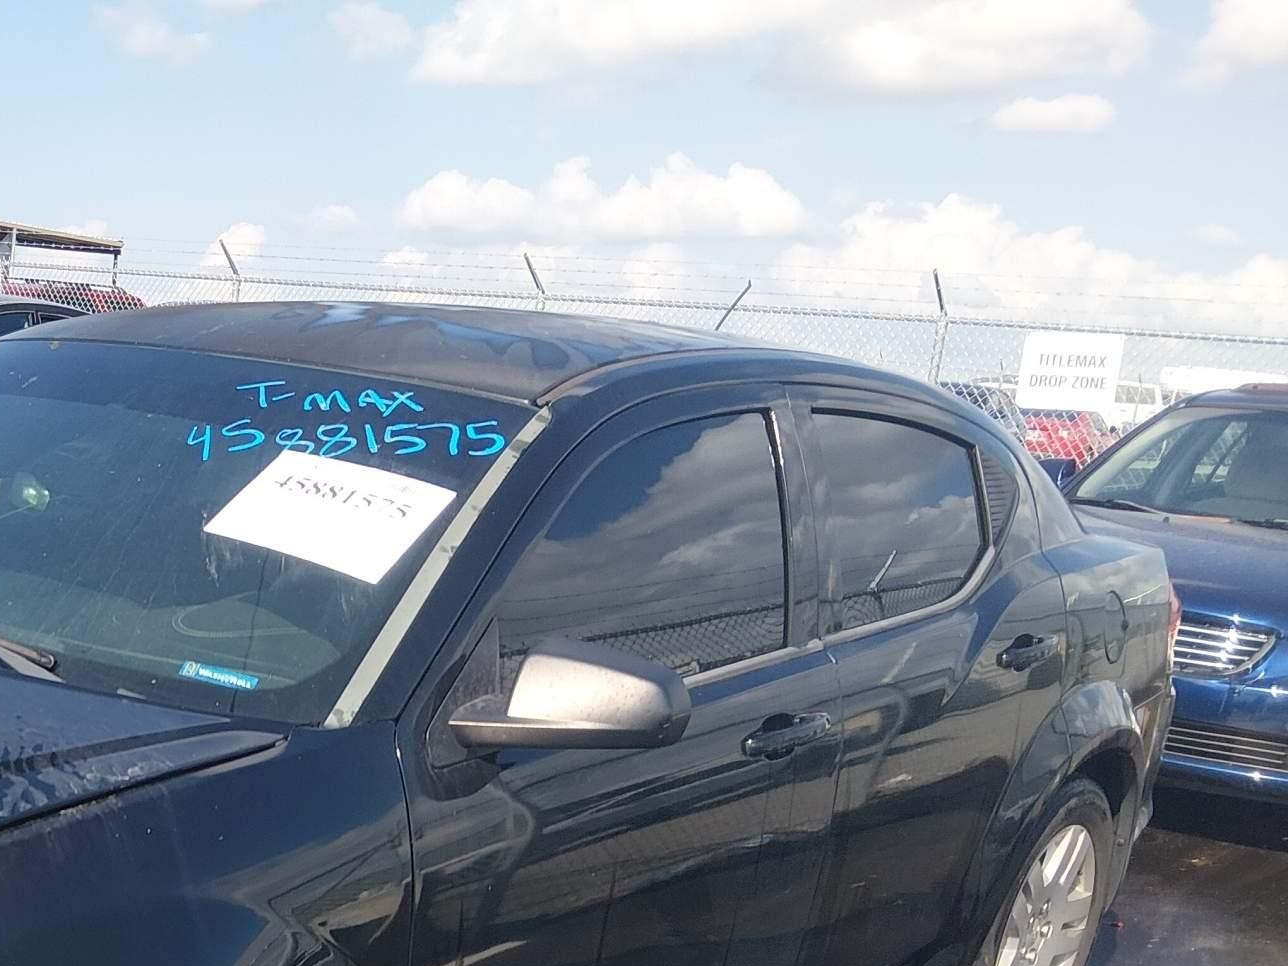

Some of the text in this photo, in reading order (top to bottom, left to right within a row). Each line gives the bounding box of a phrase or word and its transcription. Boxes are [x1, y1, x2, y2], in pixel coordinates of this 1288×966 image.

[1039, 353, 1108, 368] TITLEMAX
[1028, 374, 1109, 390] DROP ZONE
[186, 419, 506, 461] 45881575
